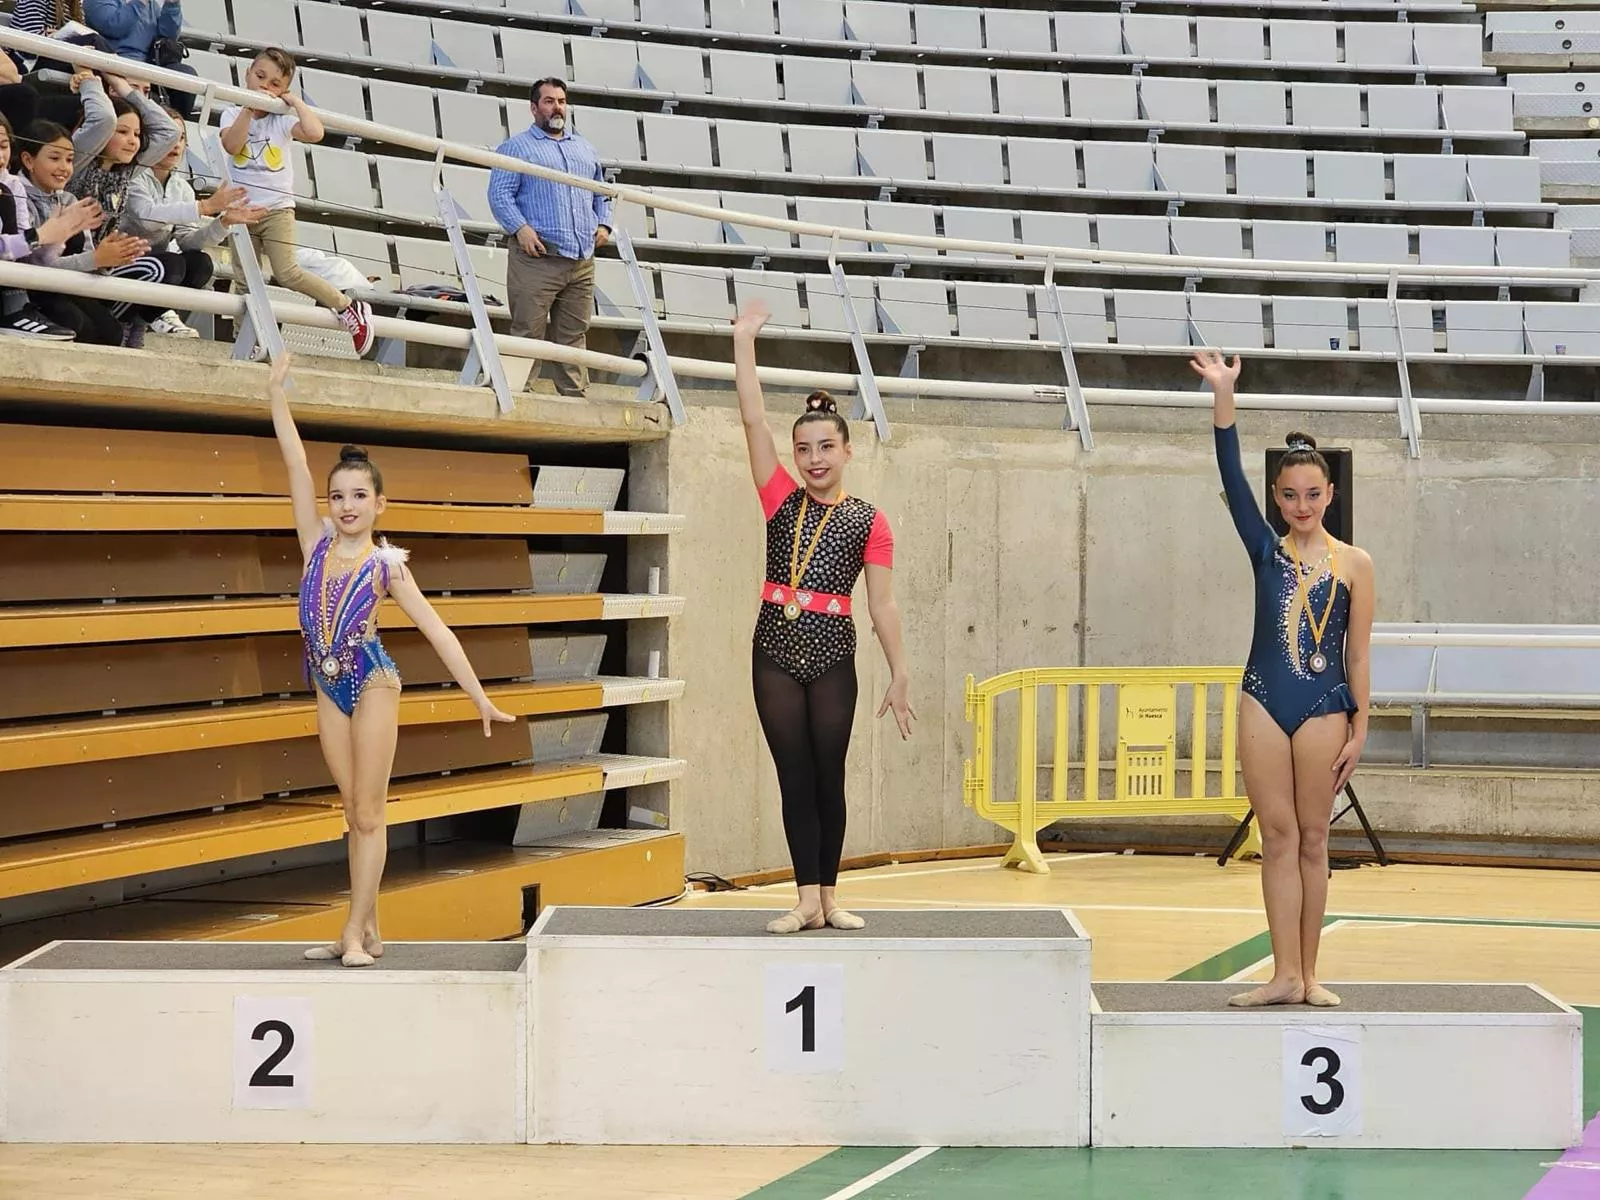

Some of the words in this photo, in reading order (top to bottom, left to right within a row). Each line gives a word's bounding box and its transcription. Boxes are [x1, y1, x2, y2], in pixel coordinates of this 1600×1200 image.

[785, 986, 816, 1052] 1
[249, 1020, 295, 1087] 2
[1300, 1047, 1345, 1115] 3
